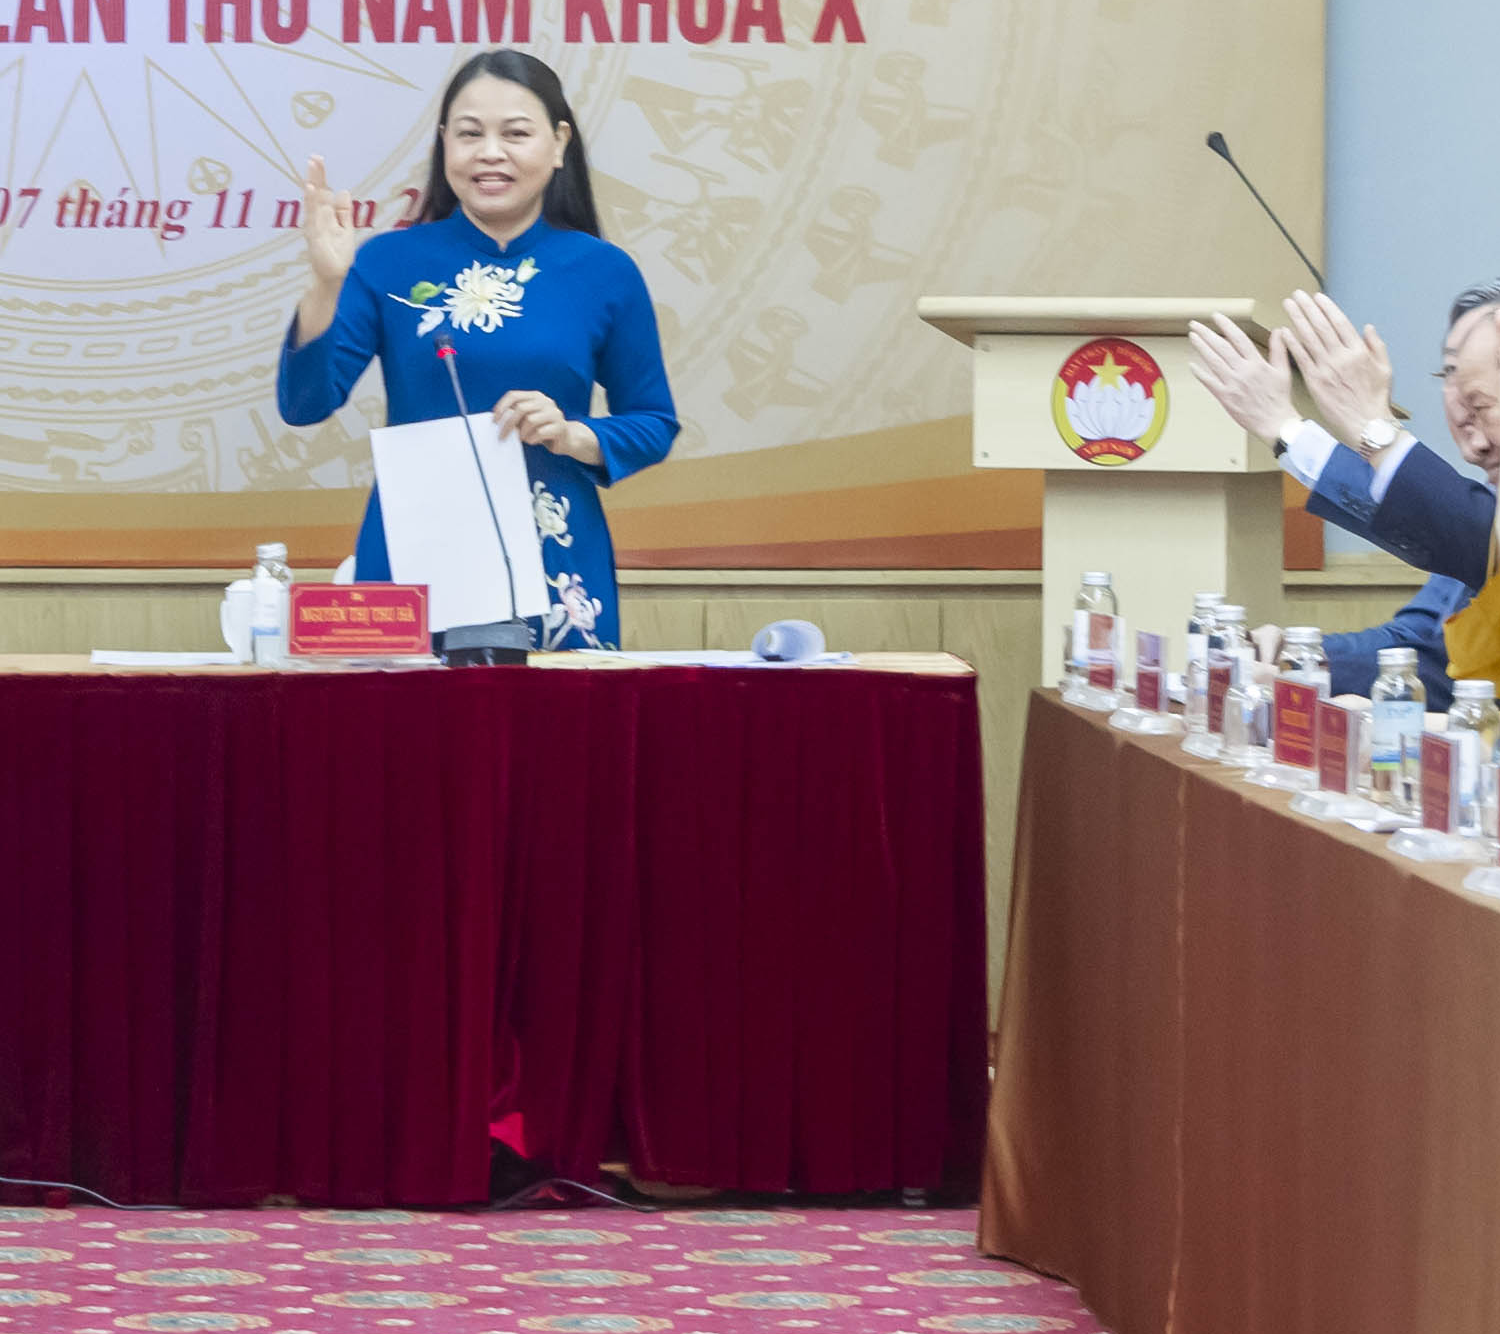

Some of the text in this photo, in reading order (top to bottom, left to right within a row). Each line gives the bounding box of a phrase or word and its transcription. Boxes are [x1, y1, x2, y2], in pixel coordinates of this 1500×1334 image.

[53, 186, 191, 242] tháng
[207, 187, 255, 229] 11
[272, 198, 377, 229] nm
